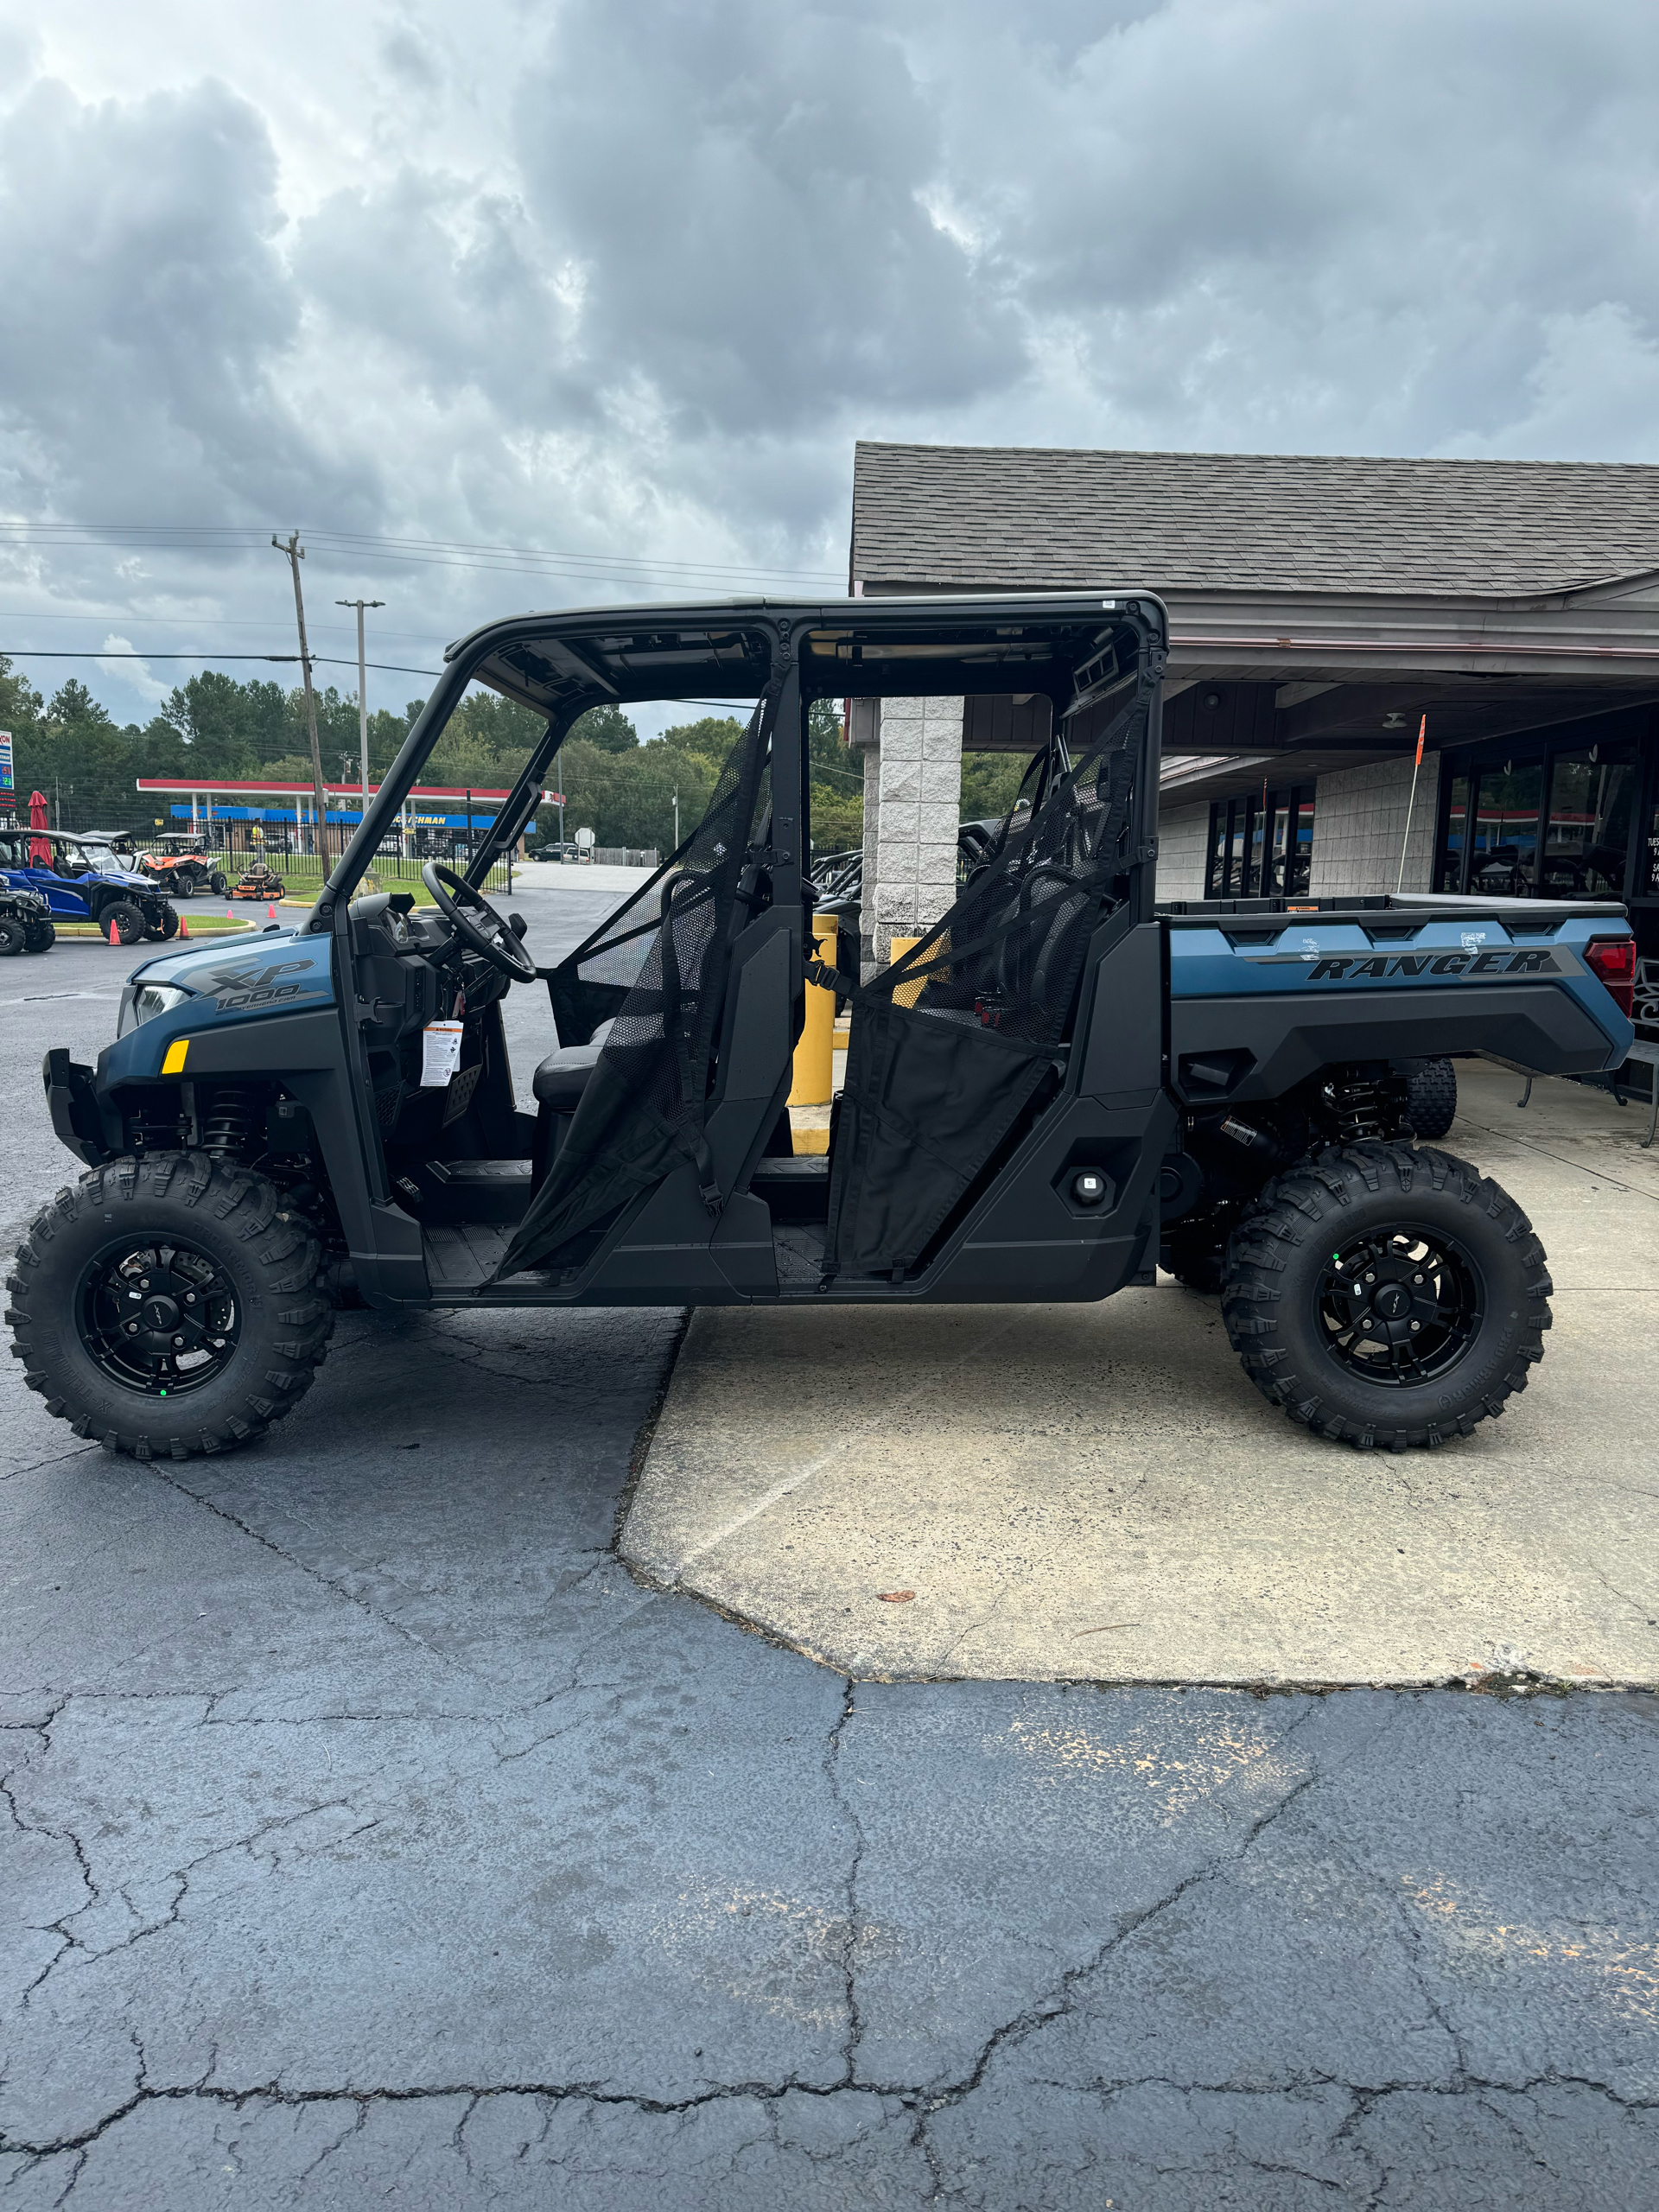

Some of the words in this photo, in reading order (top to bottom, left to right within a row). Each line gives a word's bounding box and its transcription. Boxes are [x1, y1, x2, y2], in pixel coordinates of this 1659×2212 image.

[392, 816, 446, 824] CTHMAN
[192, 958, 317, 1002] XP
[1305, 950, 1553, 981] RANGER
[215, 983, 300, 1011] 1000
[1494, 1326, 1514, 1358] PRO
[41, 1329, 114, 1415] X-TERRAIN
[1452, 1358, 1499, 1402] ARMOR
